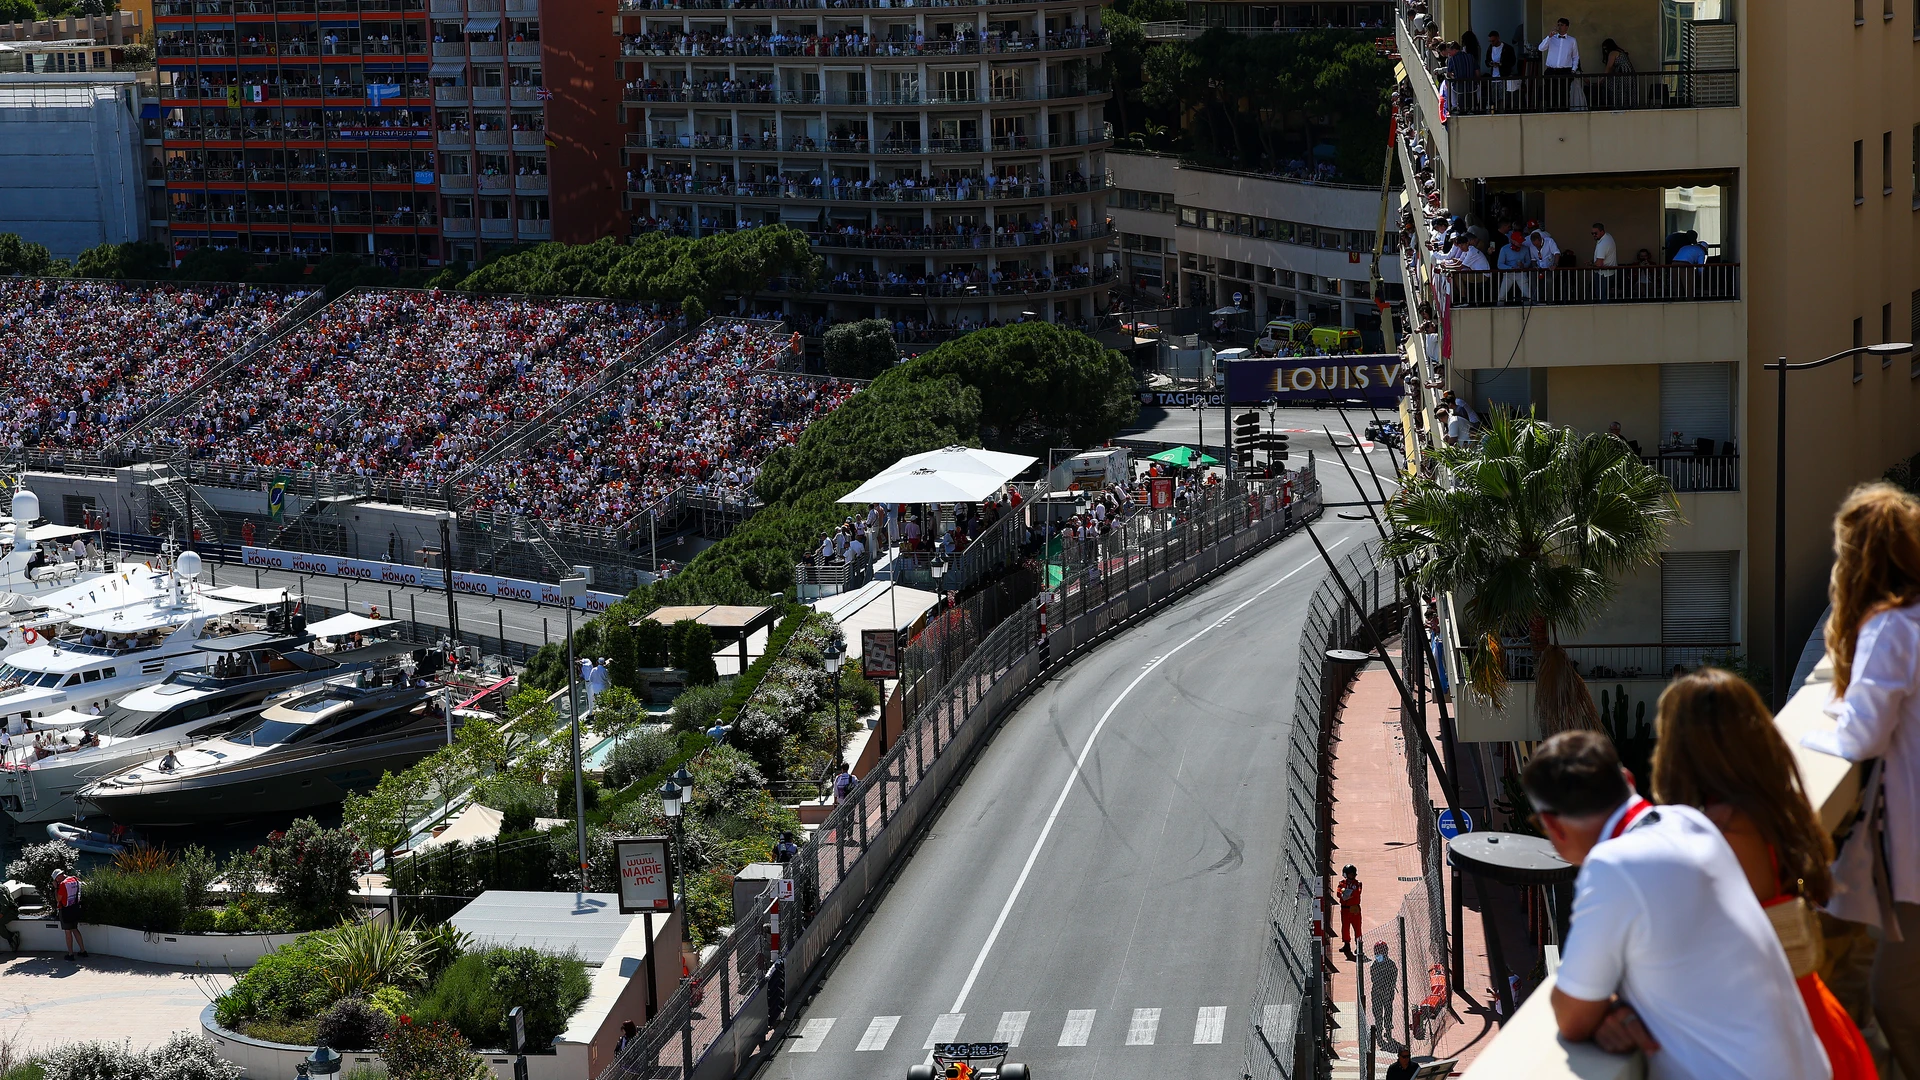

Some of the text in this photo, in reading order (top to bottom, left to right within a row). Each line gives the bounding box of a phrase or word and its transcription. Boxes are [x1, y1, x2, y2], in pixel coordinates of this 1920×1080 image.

[1277, 365, 1370, 392] LOUIS
[248, 556, 282, 567] MONACO
[293, 561, 327, 572] MONACO
[337, 566, 371, 578] MONACO
[382, 572, 416, 583] MONACO
[453, 581, 487, 592] MONACO
[497, 586, 531, 599] MONACO
[542, 593, 576, 606] MONAO
[626, 857, 657, 867] www.
[622, 864, 663, 878] MAIRIE
[634, 876, 655, 886] .mc
